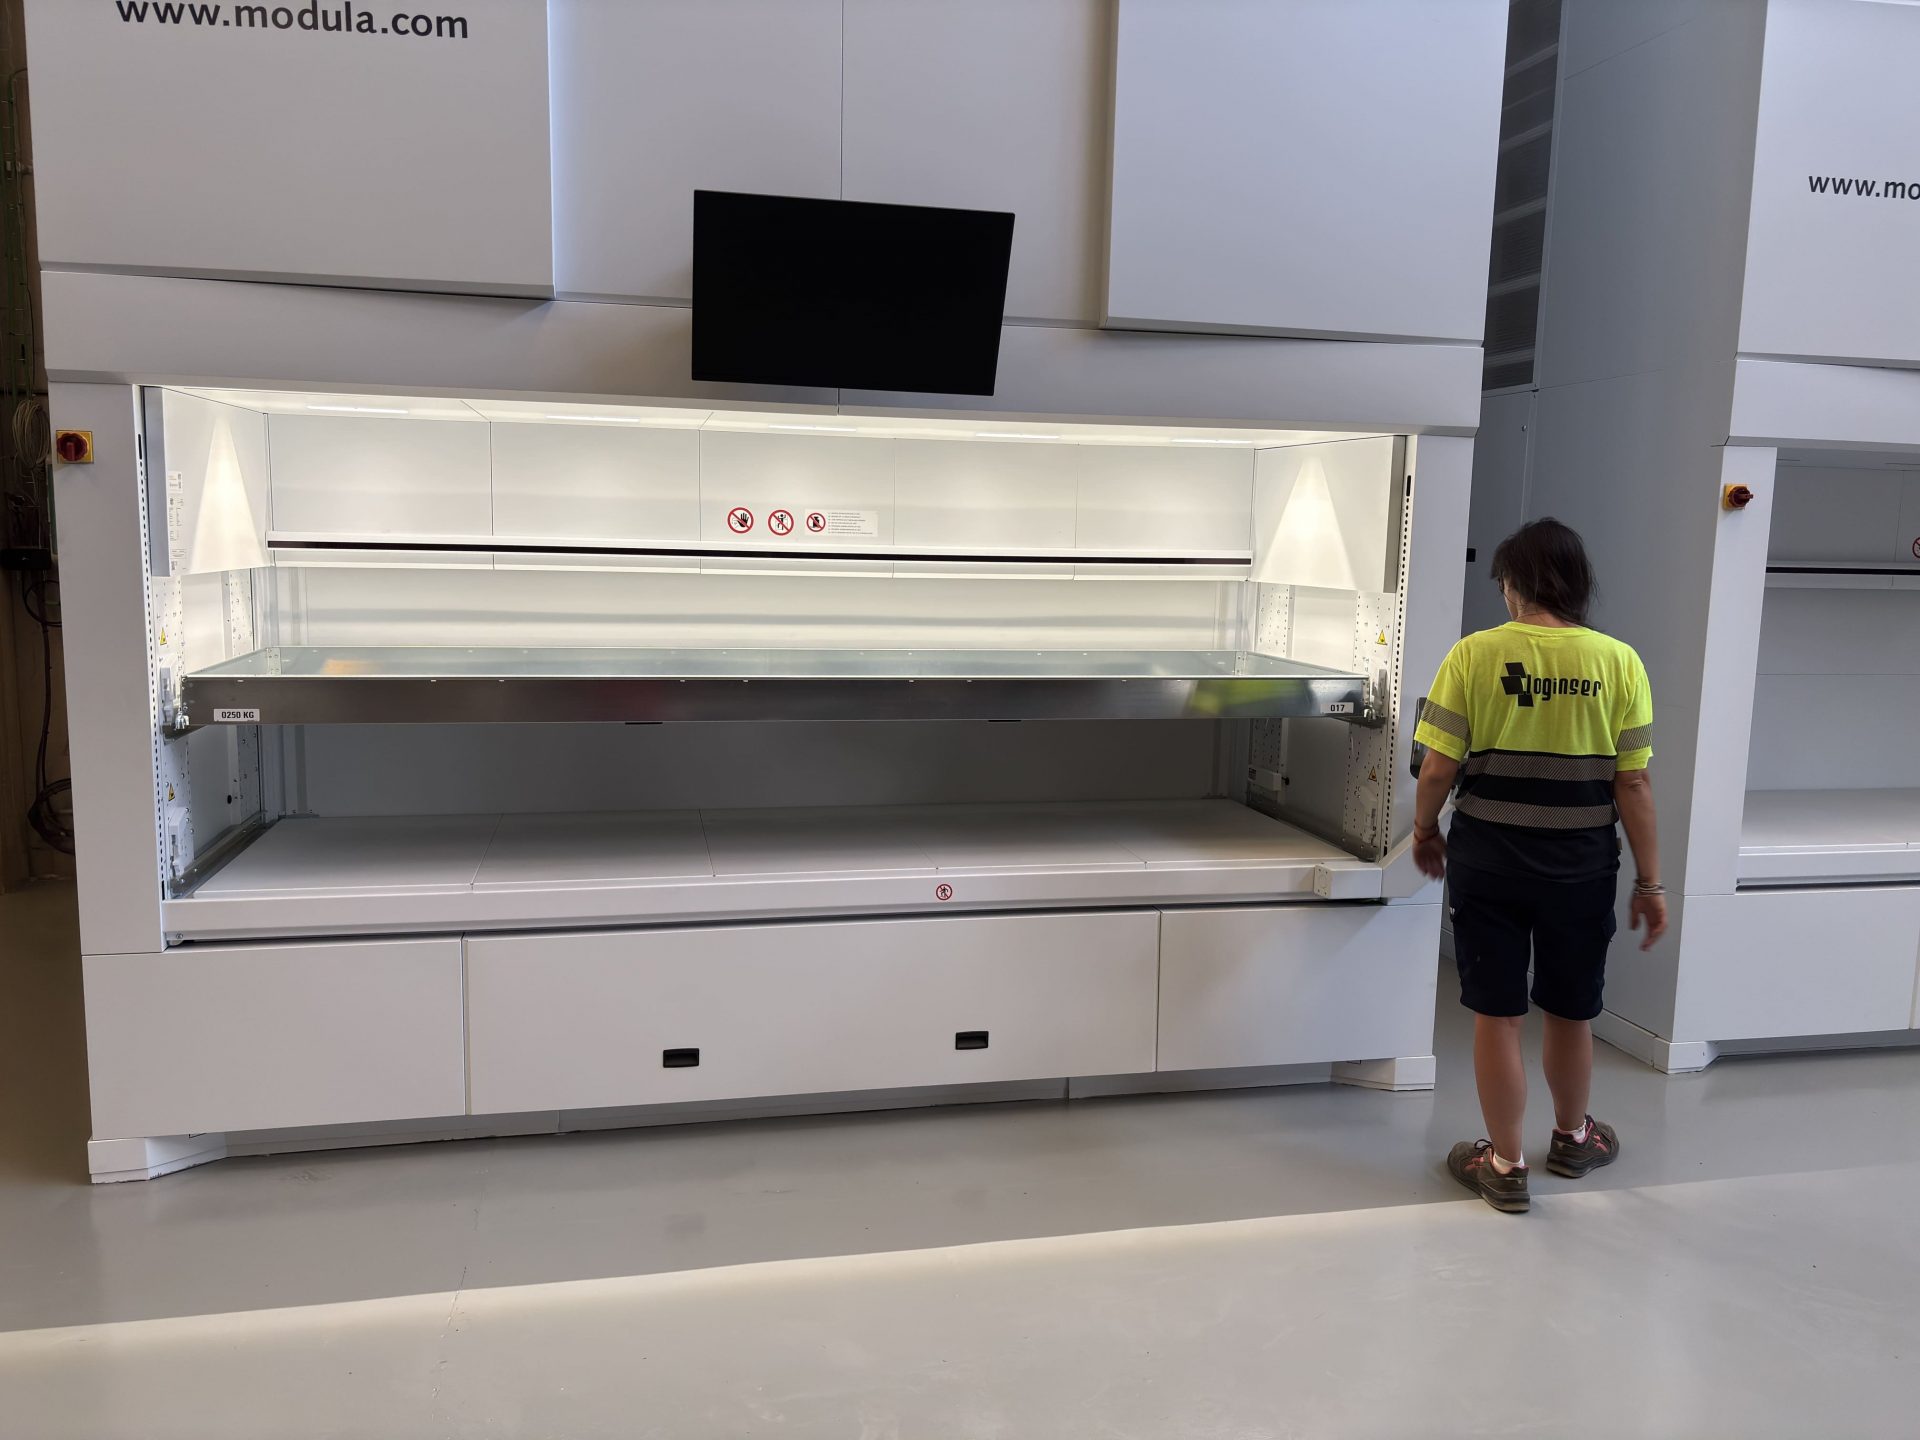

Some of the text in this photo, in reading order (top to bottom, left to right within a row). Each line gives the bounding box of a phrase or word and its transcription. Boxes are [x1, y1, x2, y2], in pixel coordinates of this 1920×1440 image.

[115, 0, 469, 39] www.modula.com
[1808, 175, 1920, 201] www.mo
[1526, 673, 1601, 702] loginser
[221, 711, 254, 719] 0250 KG
[1330, 704, 1345, 712] 017
